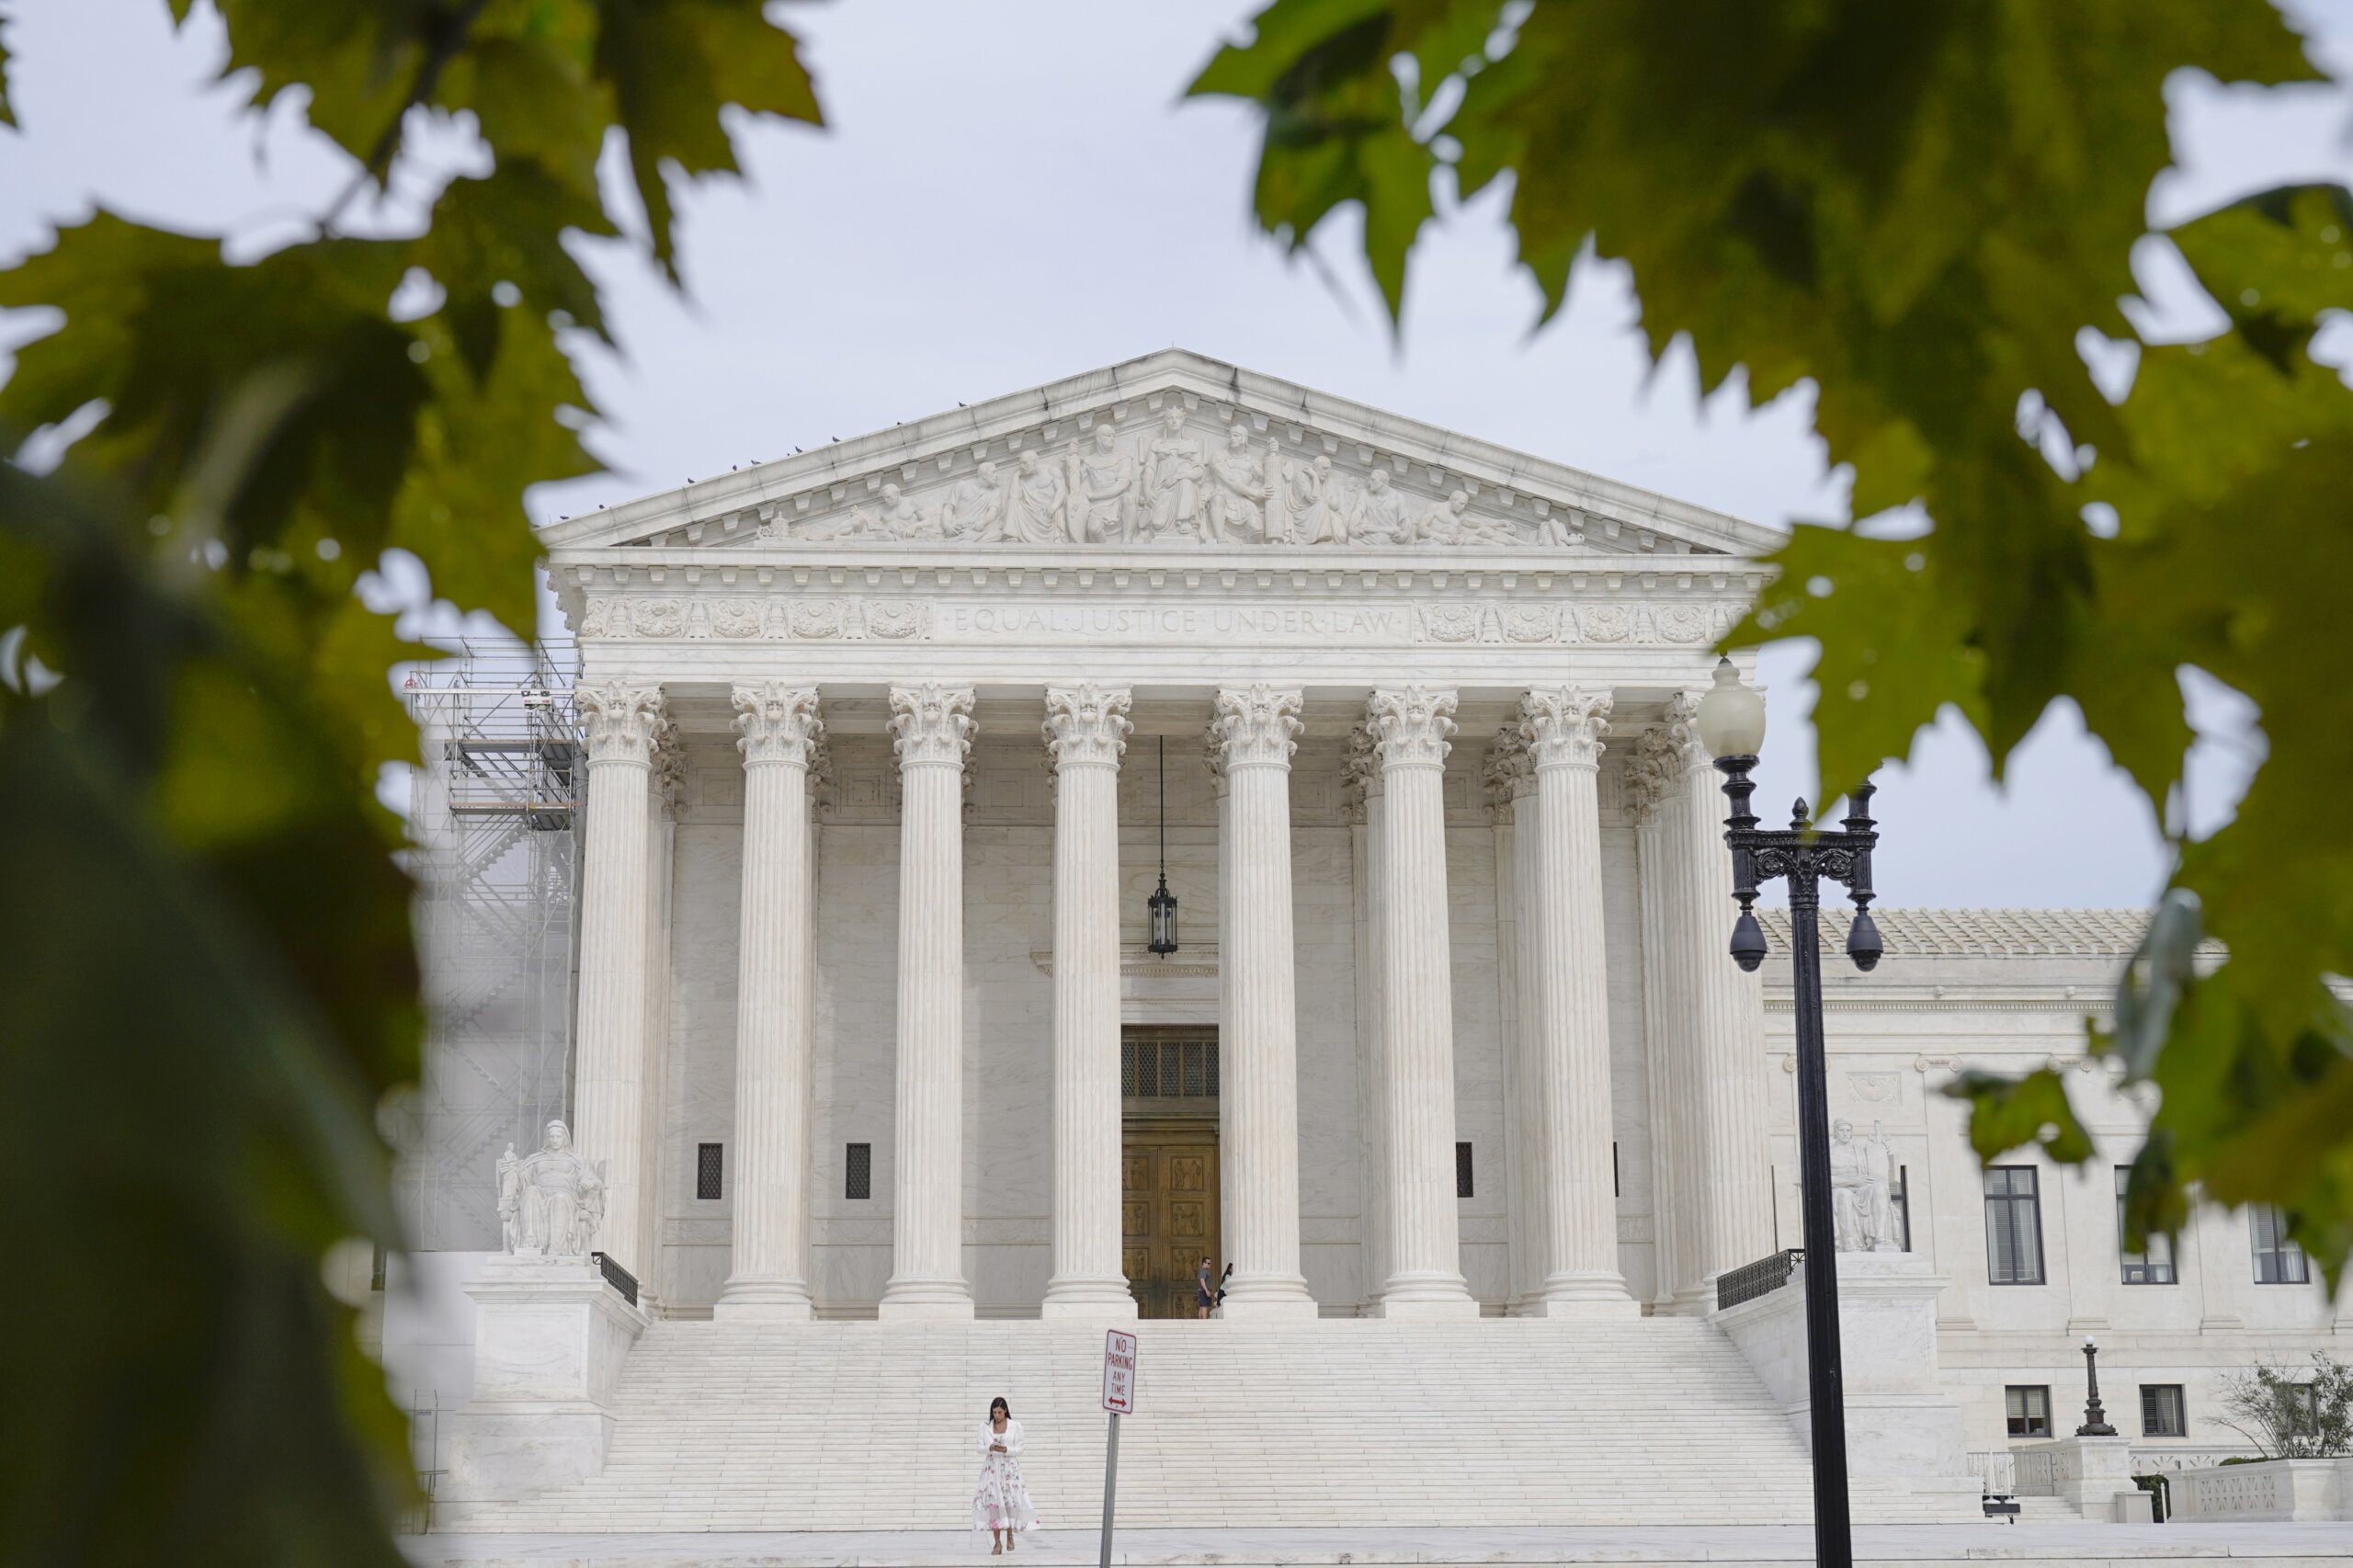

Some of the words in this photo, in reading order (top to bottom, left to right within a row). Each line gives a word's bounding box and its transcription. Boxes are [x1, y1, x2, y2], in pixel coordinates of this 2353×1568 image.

[955, 608, 1063, 633] EQUAL
[1070, 609, 1196, 632] JUSTICE
[1212, 610, 1322, 633] UNDER
[1332, 610, 1394, 633] LAW
[1115, 1337, 1127, 1353] NO
[1108, 1352, 1133, 1370] PARKING
[1112, 1370, 1126, 1383] ANY
[1111, 1382, 1126, 1396] TIME
